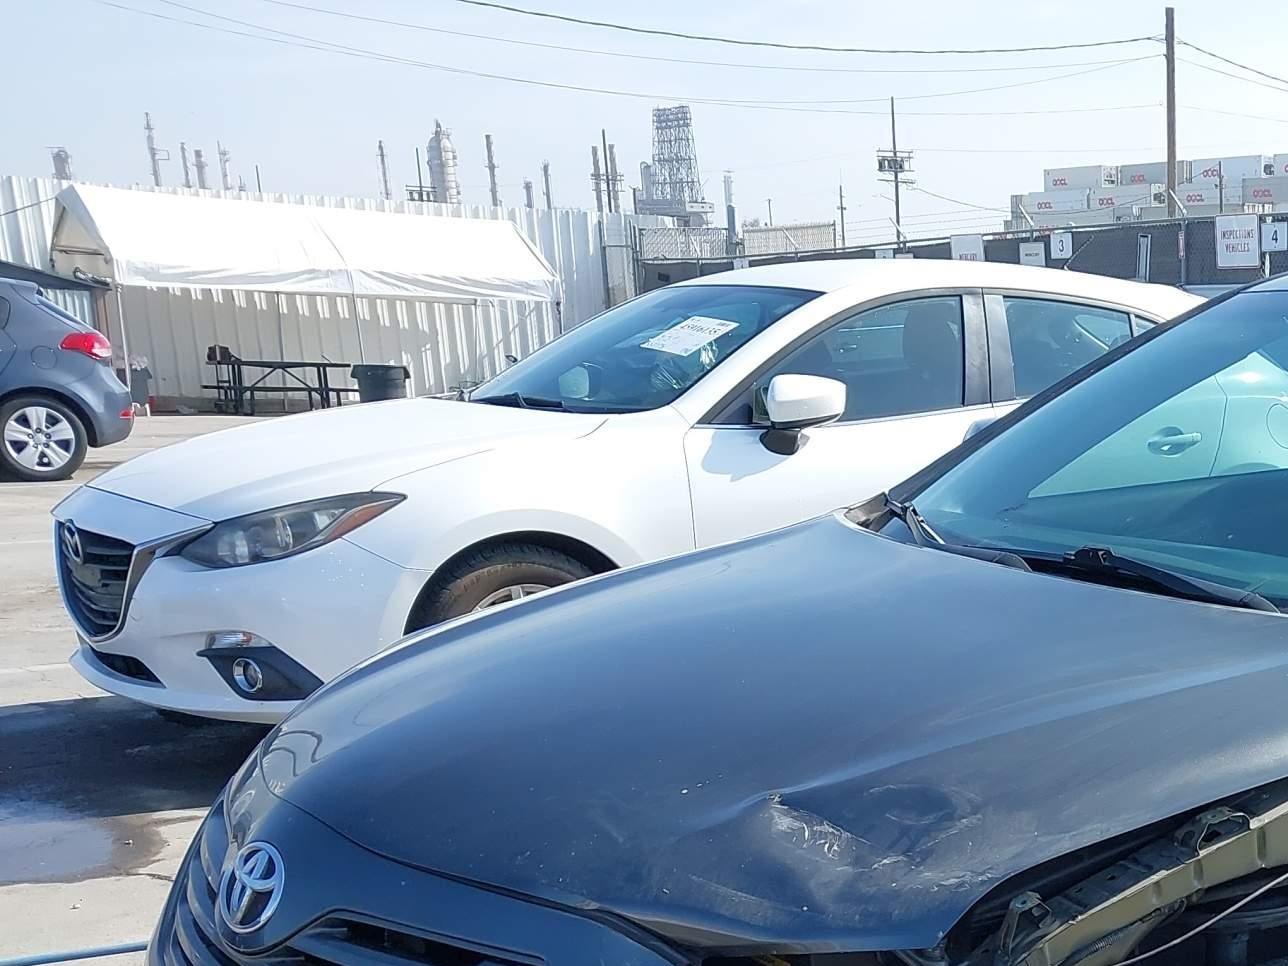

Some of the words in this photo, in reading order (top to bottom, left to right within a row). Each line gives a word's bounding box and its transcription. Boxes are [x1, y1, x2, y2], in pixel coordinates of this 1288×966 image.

[1052, 177, 1068, 187] OOCL
[1186, 193, 1205, 203] OOCL
[1252, 188, 1273, 199] OOCL
[1036, 201, 1053, 210] OOCL
[1098, 197, 1115, 207] OOCL
[1220, 229, 1254, 241] INSPECTIONS
[1271, 229, 1279, 244] 4
[1058, 239, 1065, 253] 3
[1224, 242, 1250, 254] VEHICLES
